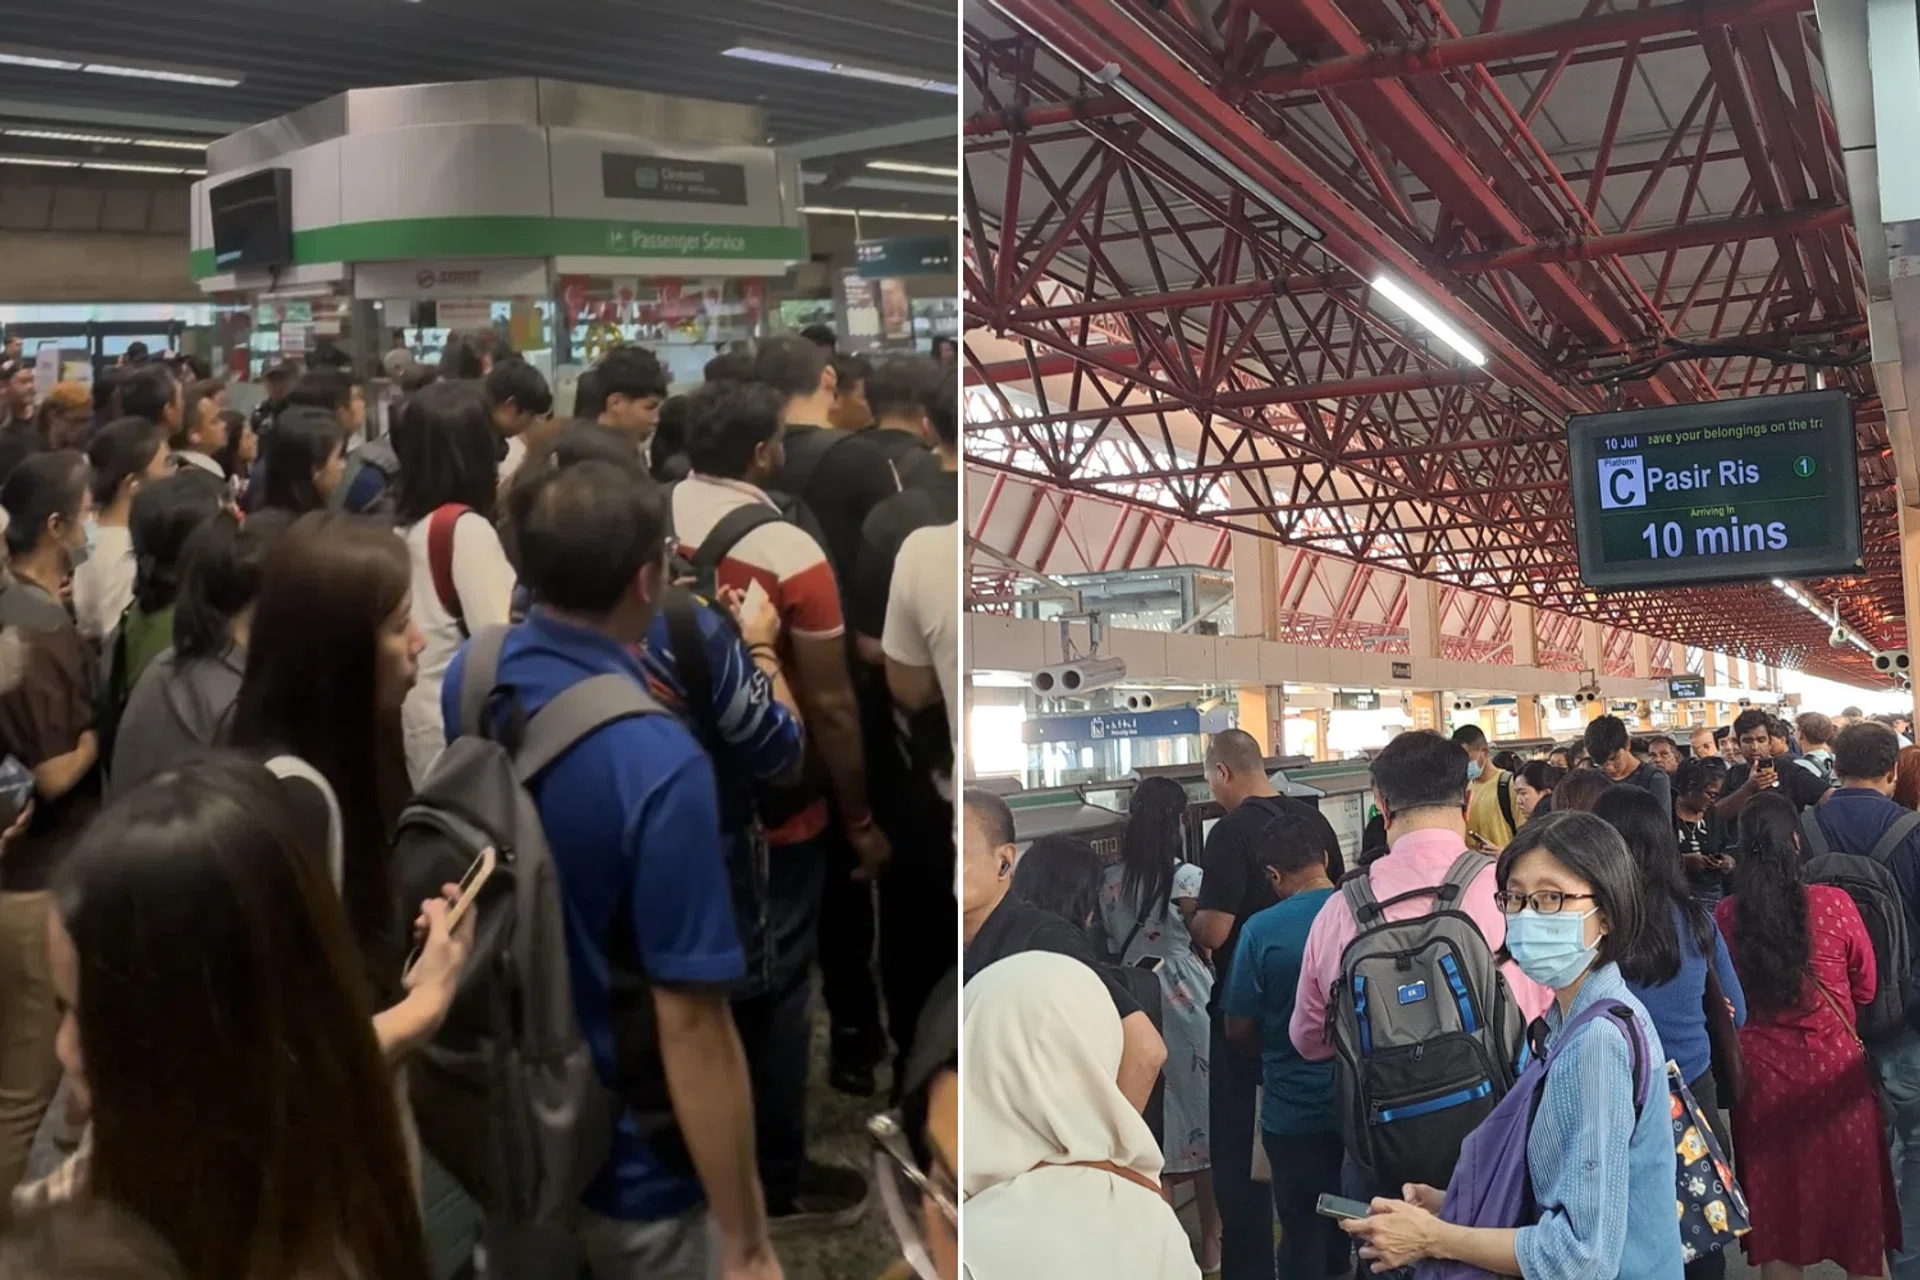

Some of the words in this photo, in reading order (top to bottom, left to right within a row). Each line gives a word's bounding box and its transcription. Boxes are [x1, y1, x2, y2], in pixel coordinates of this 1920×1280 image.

[632, 229, 699, 254] Passenger
[702, 231, 745, 251] Service
[1605, 438, 1618, 450] 10
[1621, 436, 1638, 449] Jul
[1675, 431, 1701, 445] your
[1704, 424, 1767, 438] belongings
[1771, 423, 1785, 432] on
[1788, 419, 1807, 431] the
[1604, 458, 1637, 467] Platform
[1800, 458, 1807, 473] 1
[1610, 468, 1635, 505] C
[1647, 463, 1711, 492] Pasir
[1719, 460, 1759, 486] Ris
[1690, 506, 1724, 517] Arriving
[1726, 505, 1735, 514] In
[1642, 521, 1683, 558] 10
[1696, 516, 1788, 555] mins
